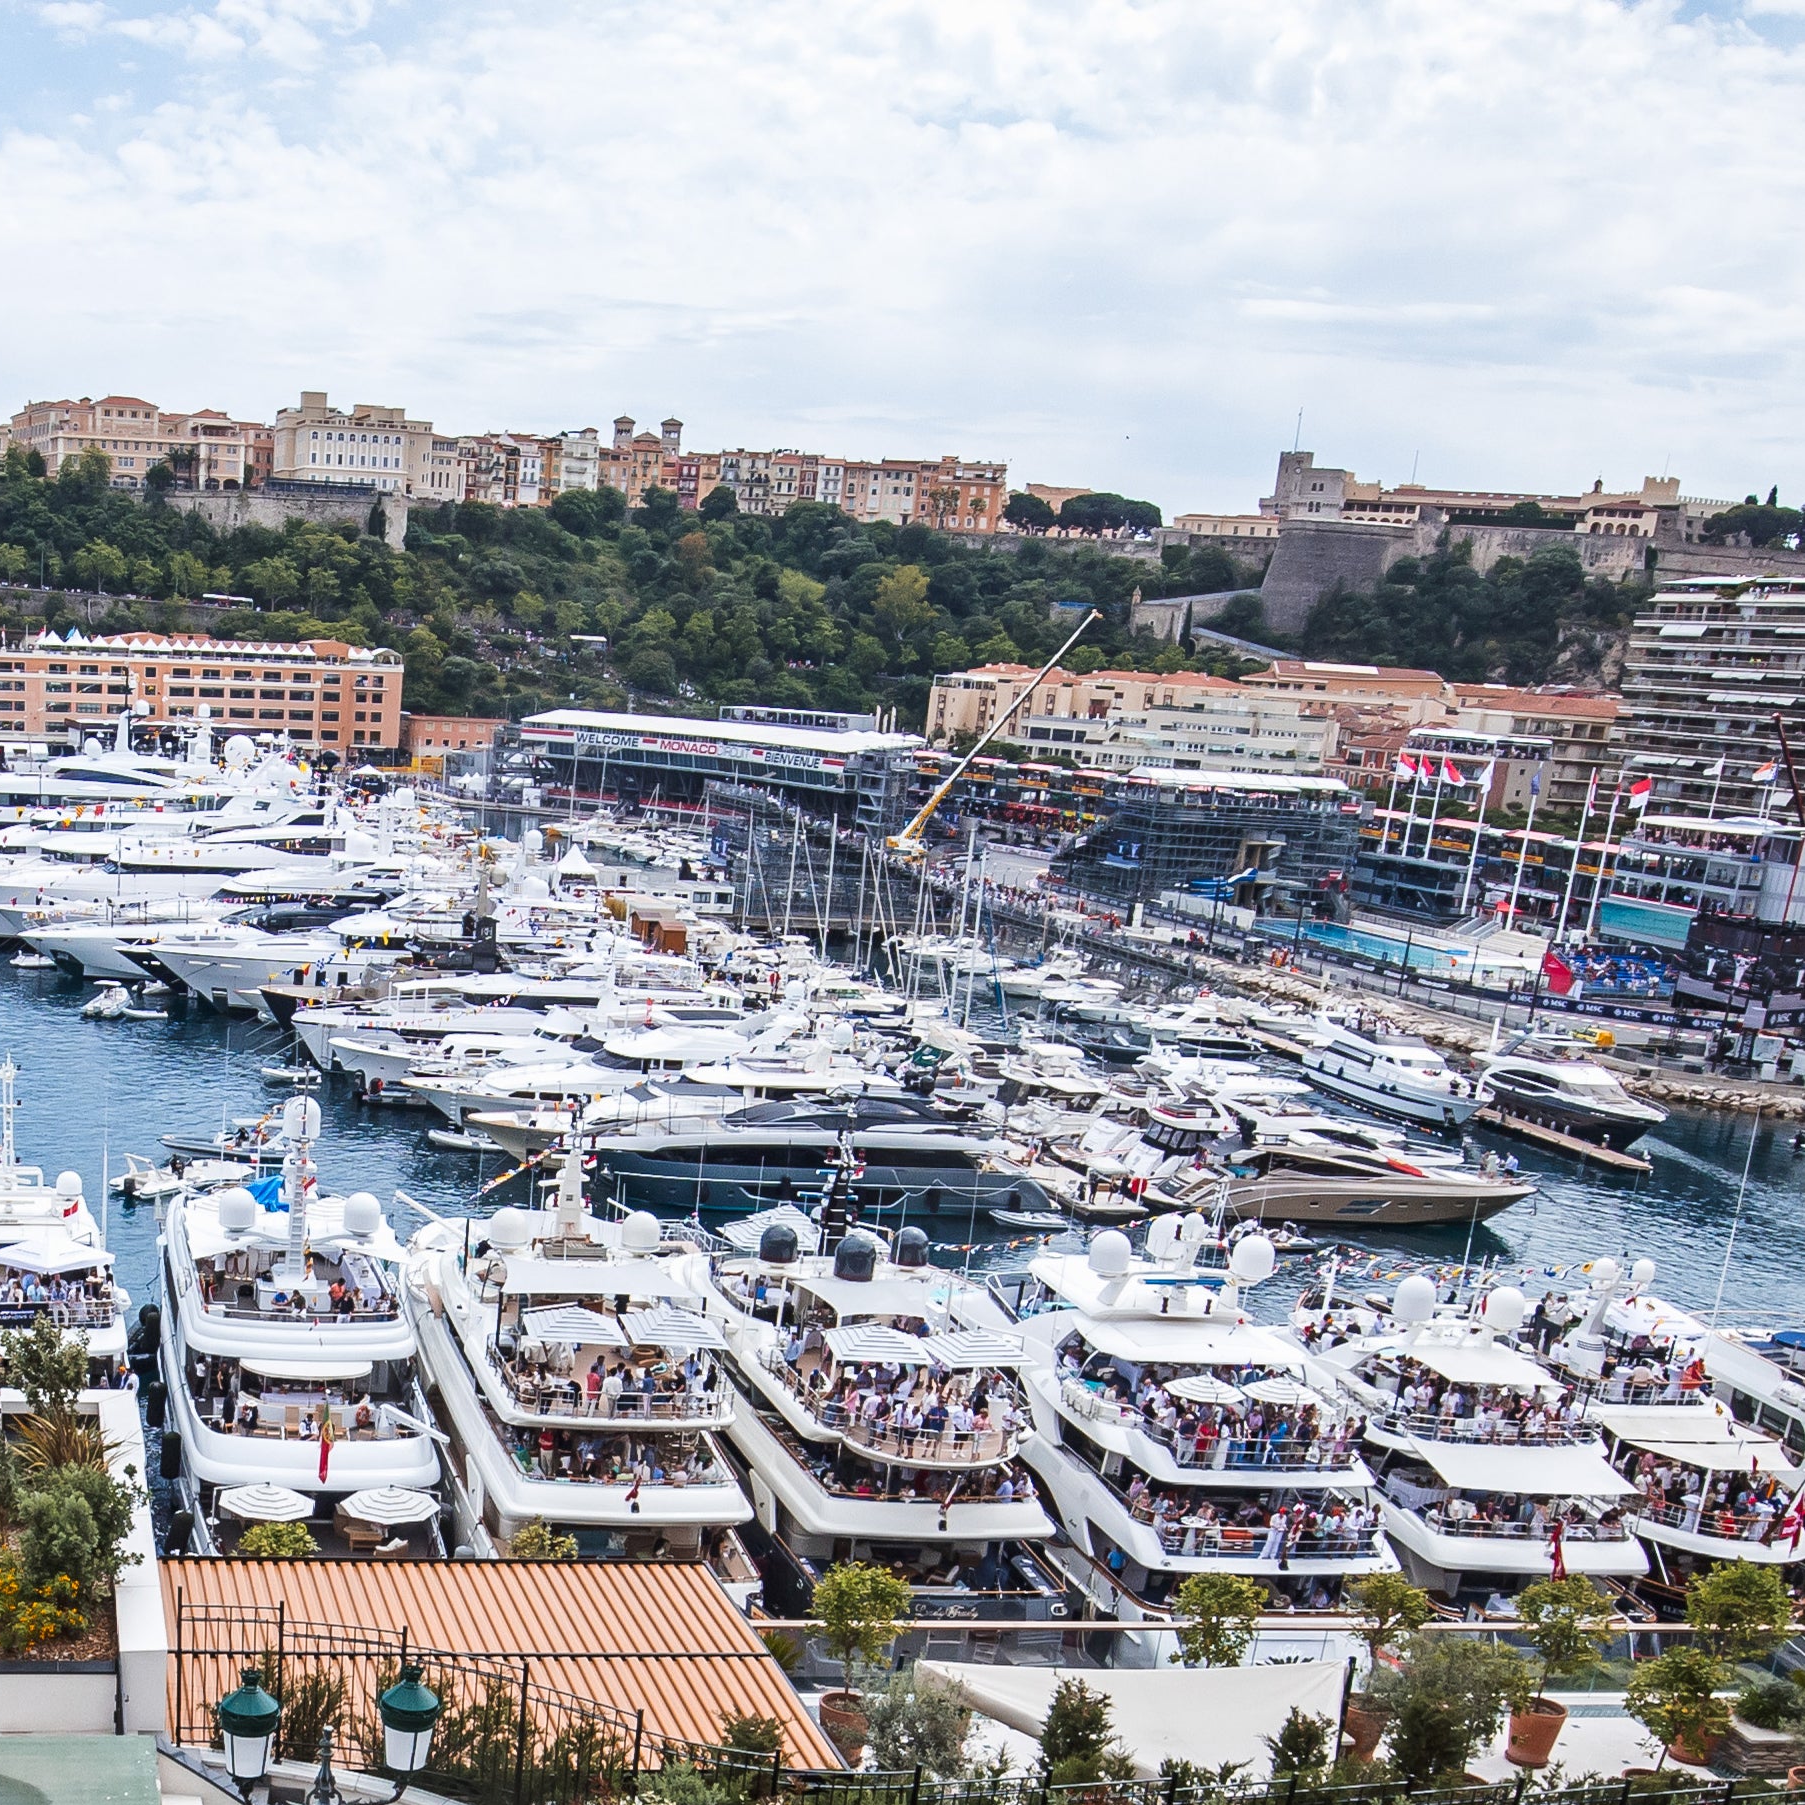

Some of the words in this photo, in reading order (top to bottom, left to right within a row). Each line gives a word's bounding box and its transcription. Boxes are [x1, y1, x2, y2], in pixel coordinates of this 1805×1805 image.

[576, 732, 639, 748] WELCOME
[660, 739, 717, 755] MONACO
[764, 752, 820, 769] BIENVENUE
